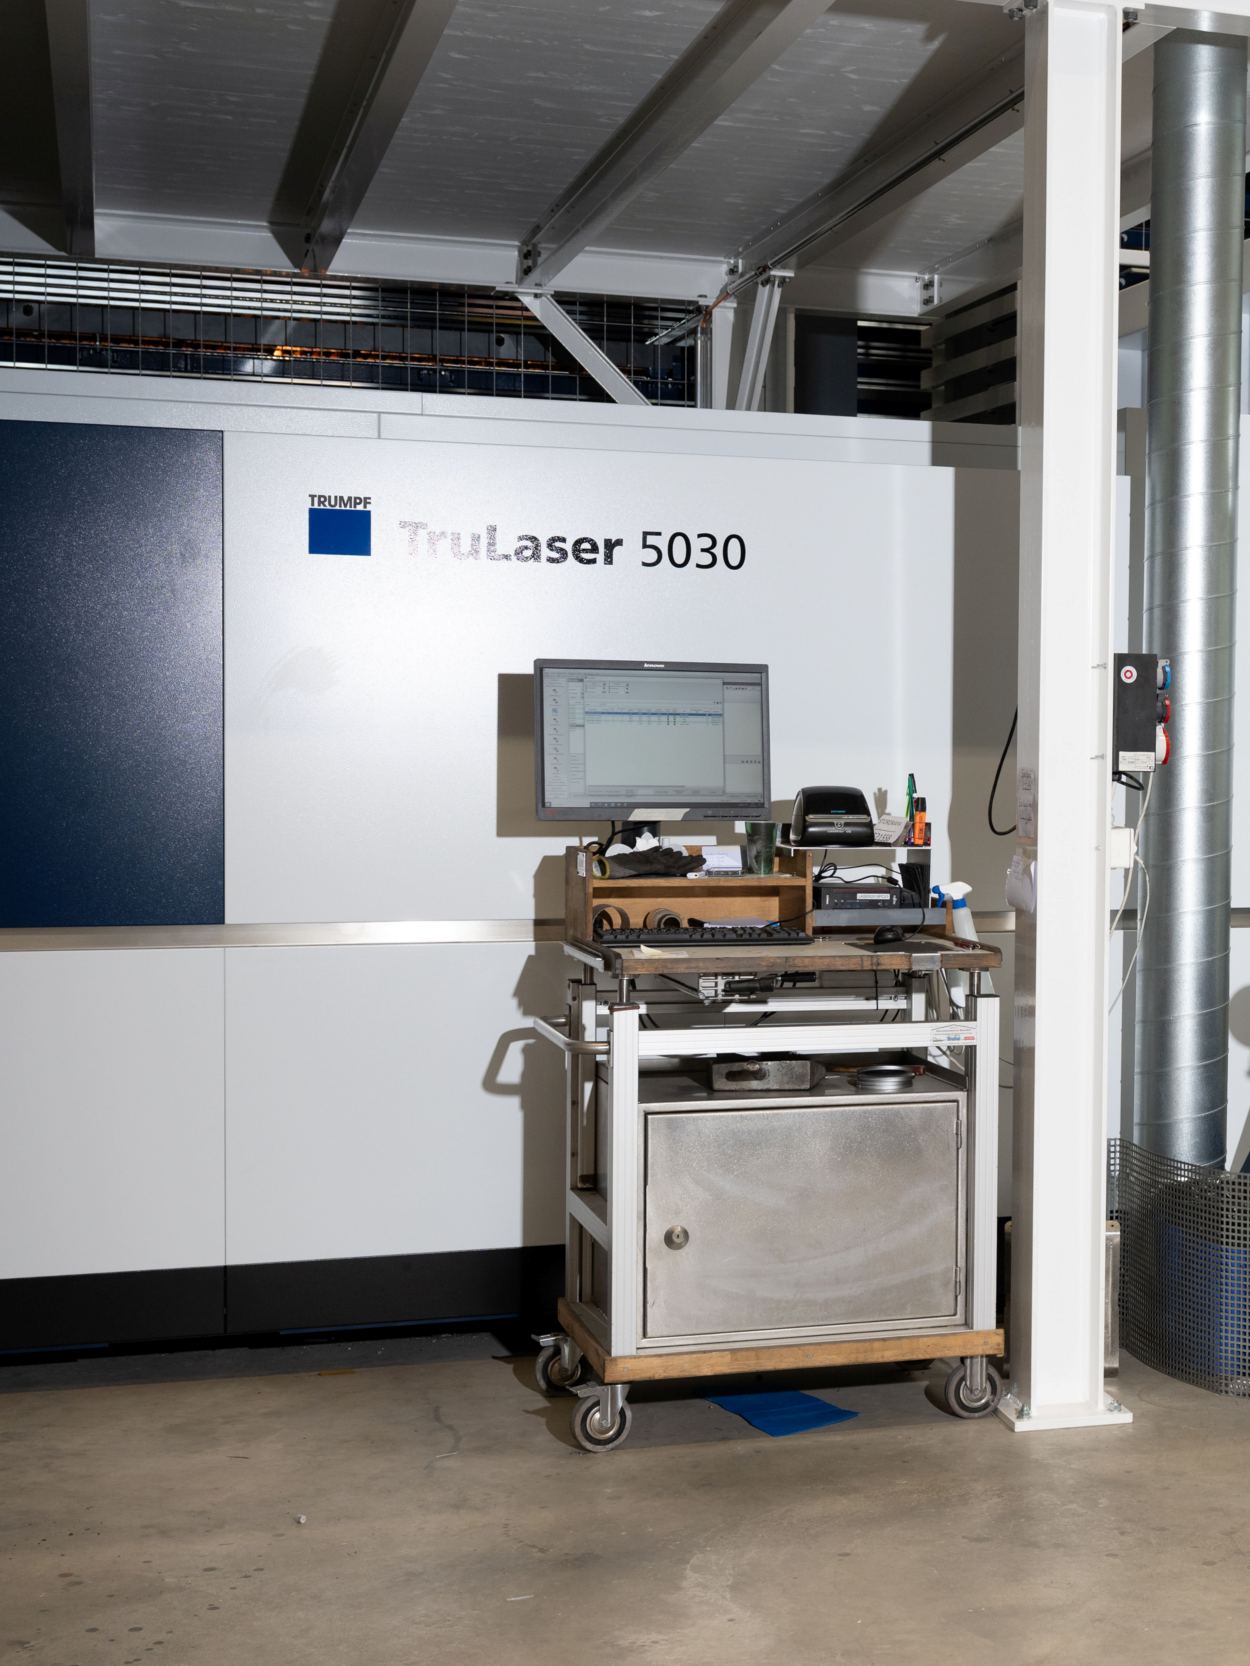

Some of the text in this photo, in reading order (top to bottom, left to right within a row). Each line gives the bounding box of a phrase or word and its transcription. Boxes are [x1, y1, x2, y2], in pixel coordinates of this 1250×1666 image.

[308, 494, 372, 509] TRUMPF
[398, 520, 746, 570] TruLaser 5030
